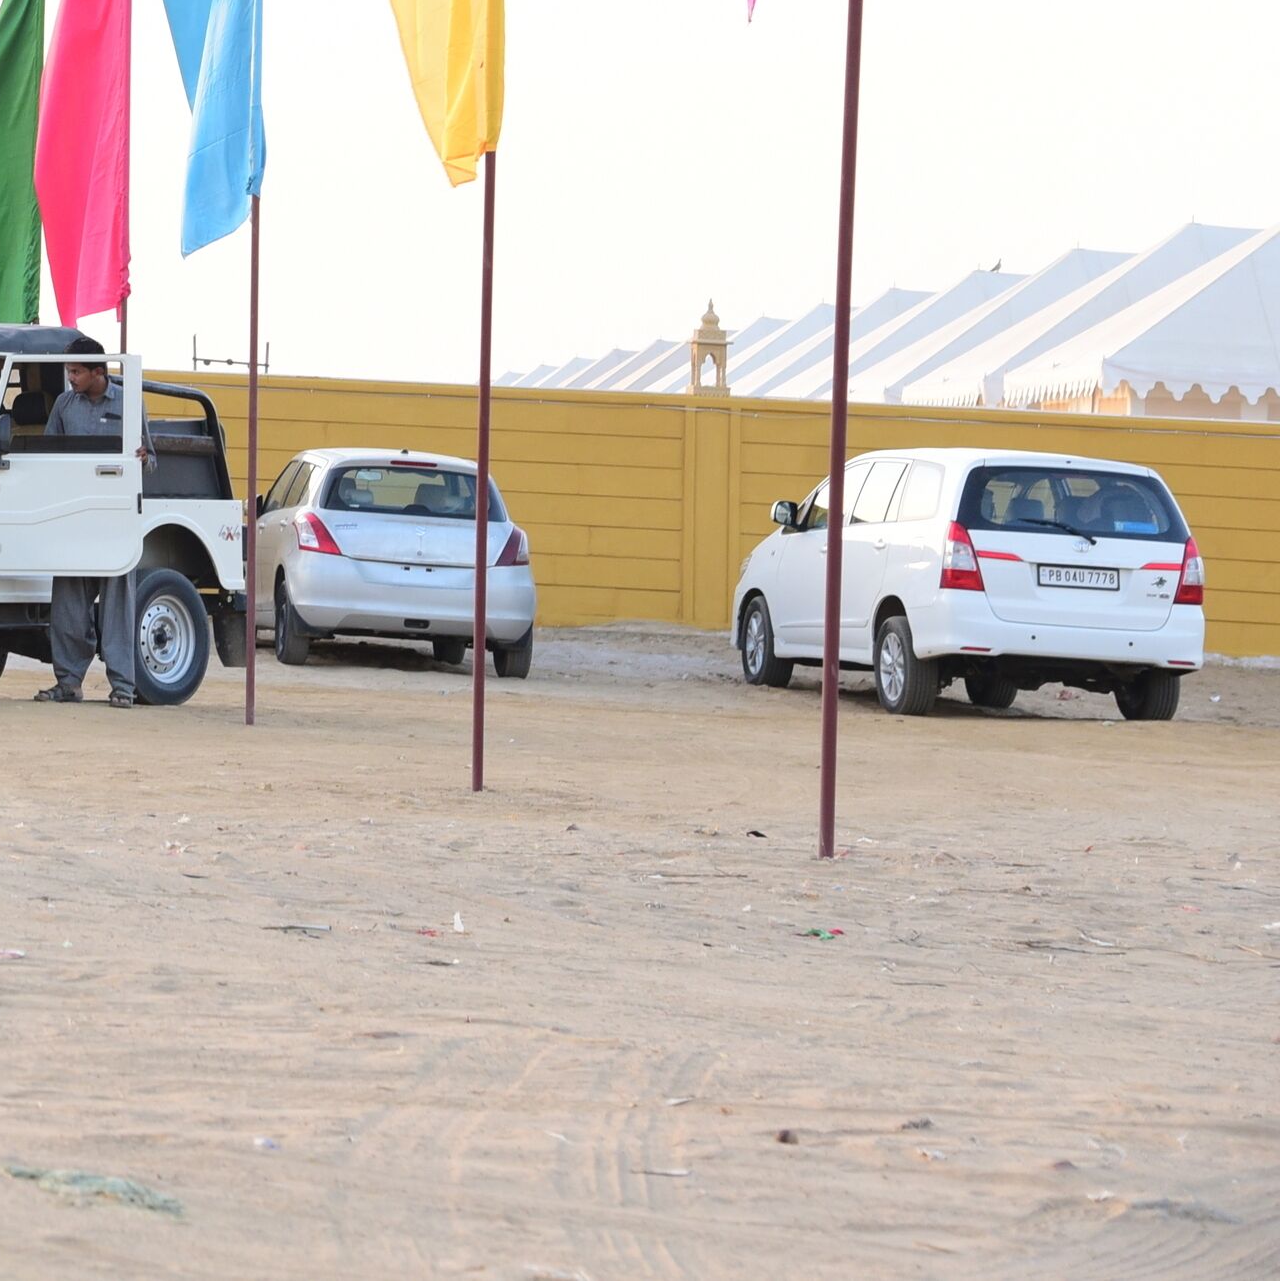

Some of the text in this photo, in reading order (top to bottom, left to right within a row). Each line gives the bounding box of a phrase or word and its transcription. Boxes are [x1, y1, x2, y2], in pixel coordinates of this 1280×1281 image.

[1048, 569, 1115, 585] PB 04U 7778
